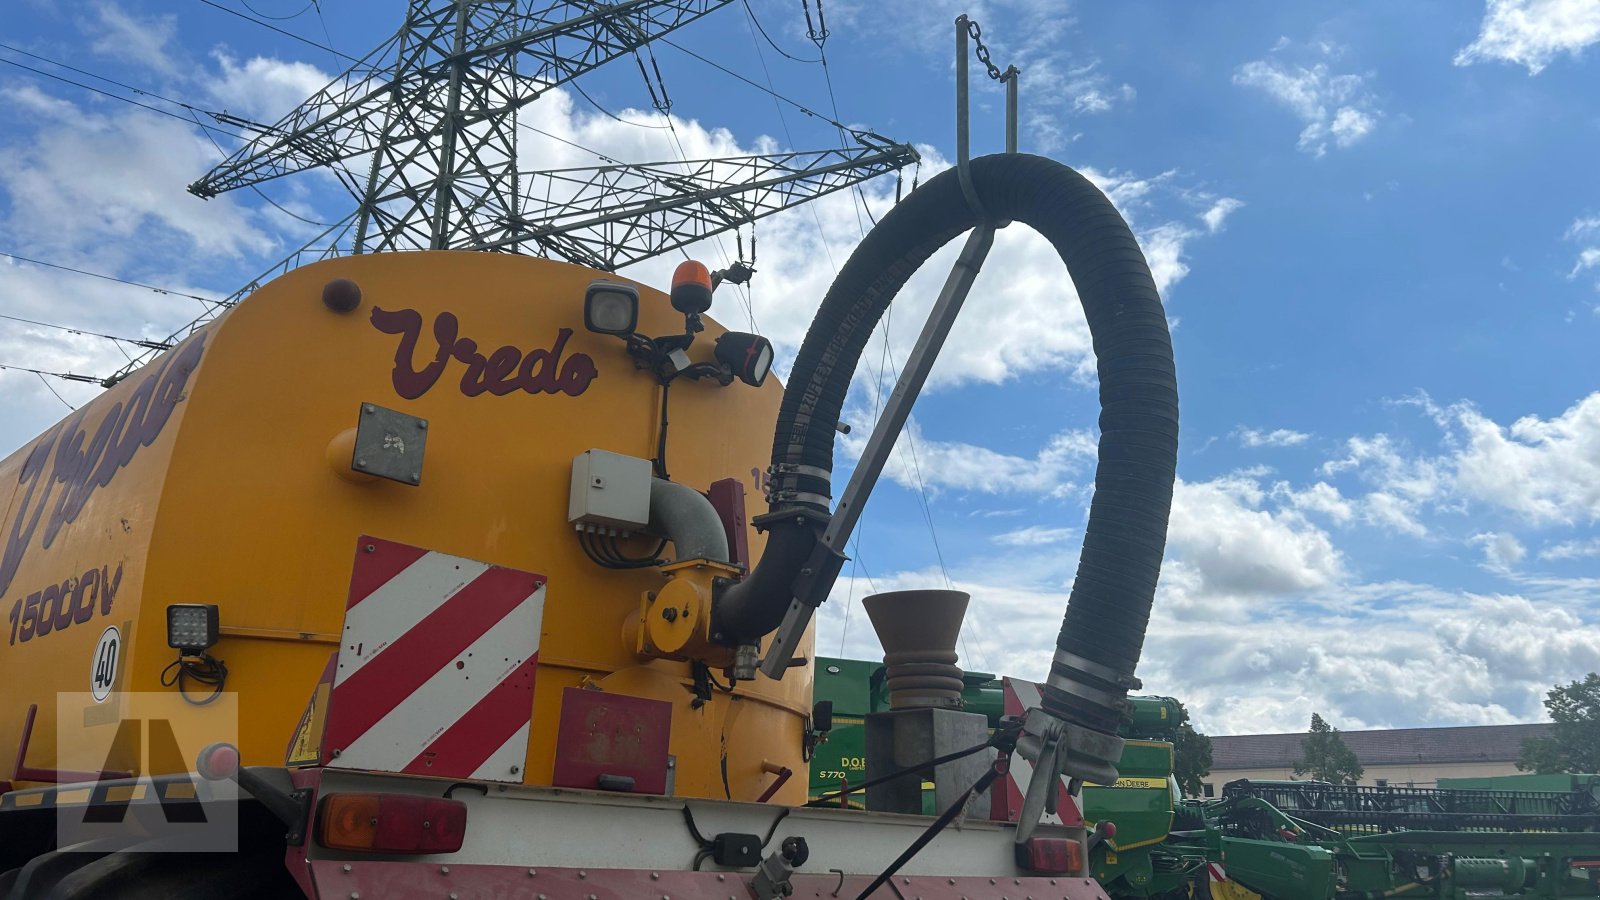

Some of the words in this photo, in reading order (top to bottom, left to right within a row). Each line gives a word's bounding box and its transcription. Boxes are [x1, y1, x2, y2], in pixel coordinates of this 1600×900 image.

[370, 306, 598, 399] Vredo
[9, 561, 123, 646] 15000V
[94, 634, 118, 689] 40
[1126, 779, 1149, 788] DEERE
